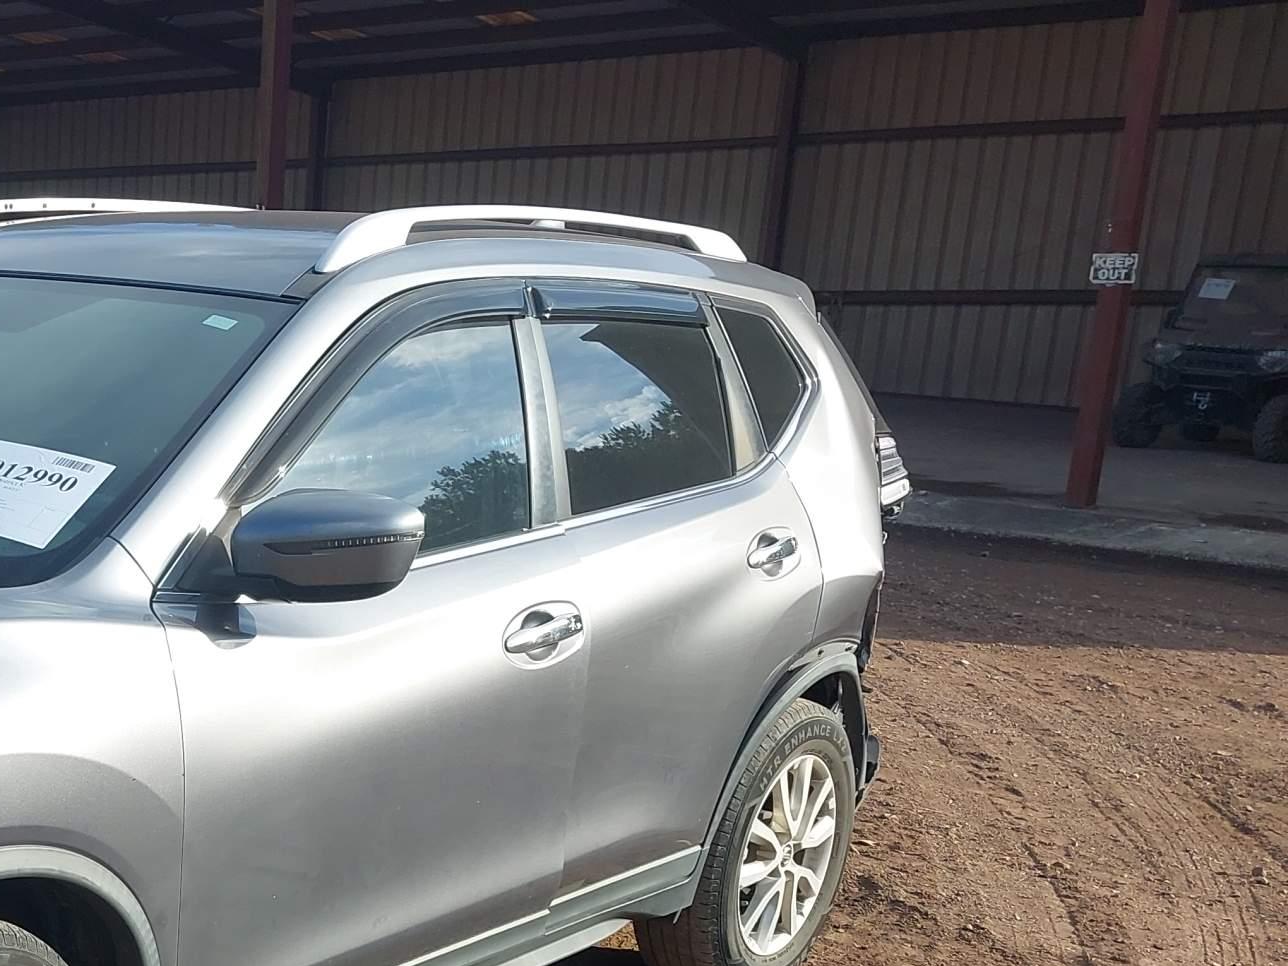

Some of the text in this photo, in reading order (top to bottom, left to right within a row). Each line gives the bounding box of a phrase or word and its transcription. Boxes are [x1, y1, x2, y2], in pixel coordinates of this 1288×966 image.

[1095, 257, 1134, 269] KEEP
[1098, 269, 1129, 280] OUT
[759, 755, 782, 791] HTR
[784, 724, 832, 755] ENHANCE
